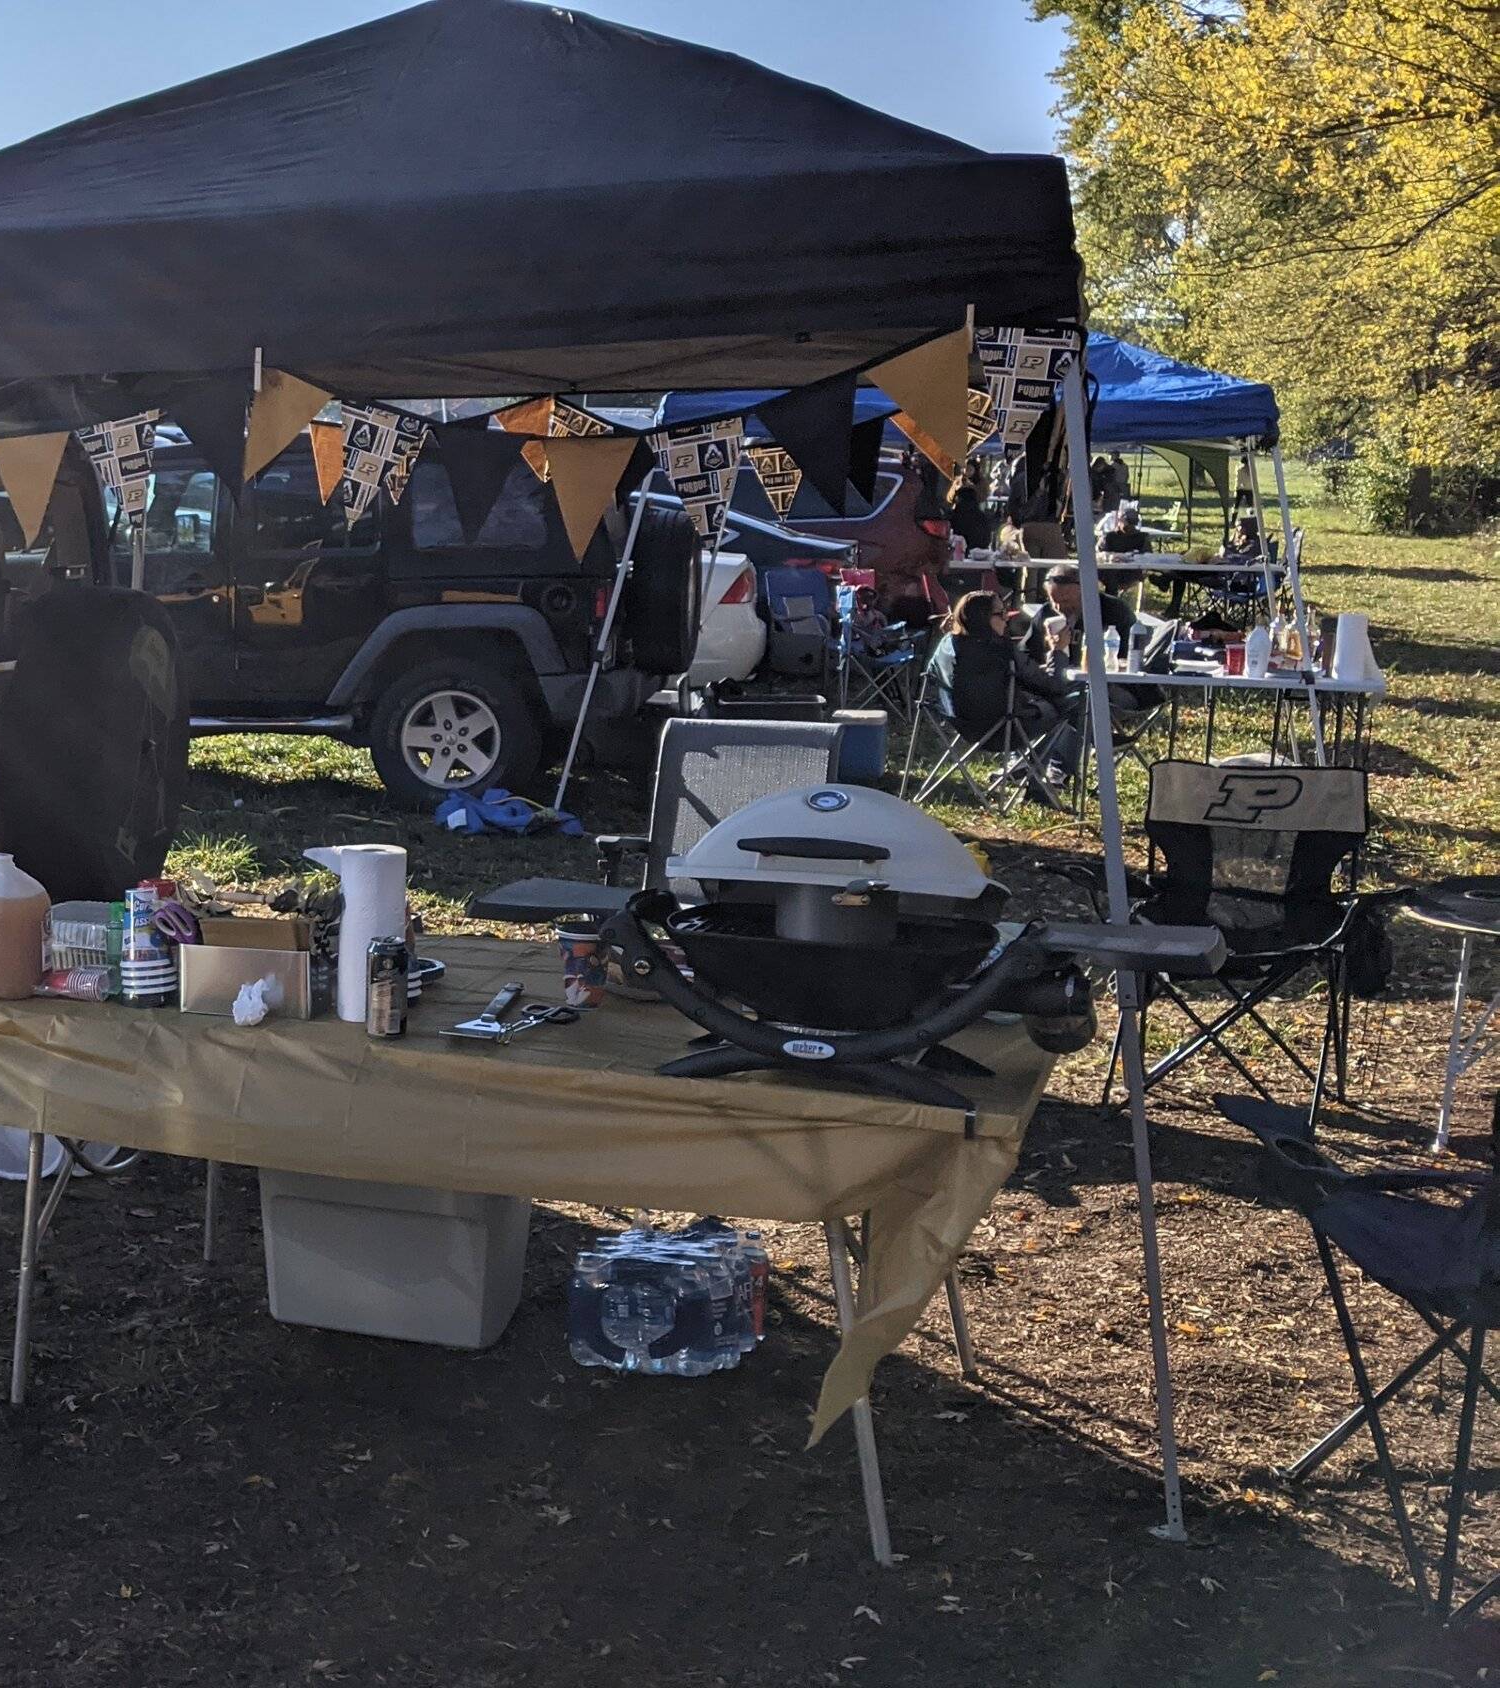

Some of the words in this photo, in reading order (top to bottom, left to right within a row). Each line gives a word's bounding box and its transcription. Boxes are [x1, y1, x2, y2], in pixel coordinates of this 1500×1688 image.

[1020, 356, 1044, 369] P
[1017, 384, 1050, 399] PURDUE
[1009, 421, 1034, 434] P
[675, 455, 695, 468] P
[1203, 774, 1303, 824] P
